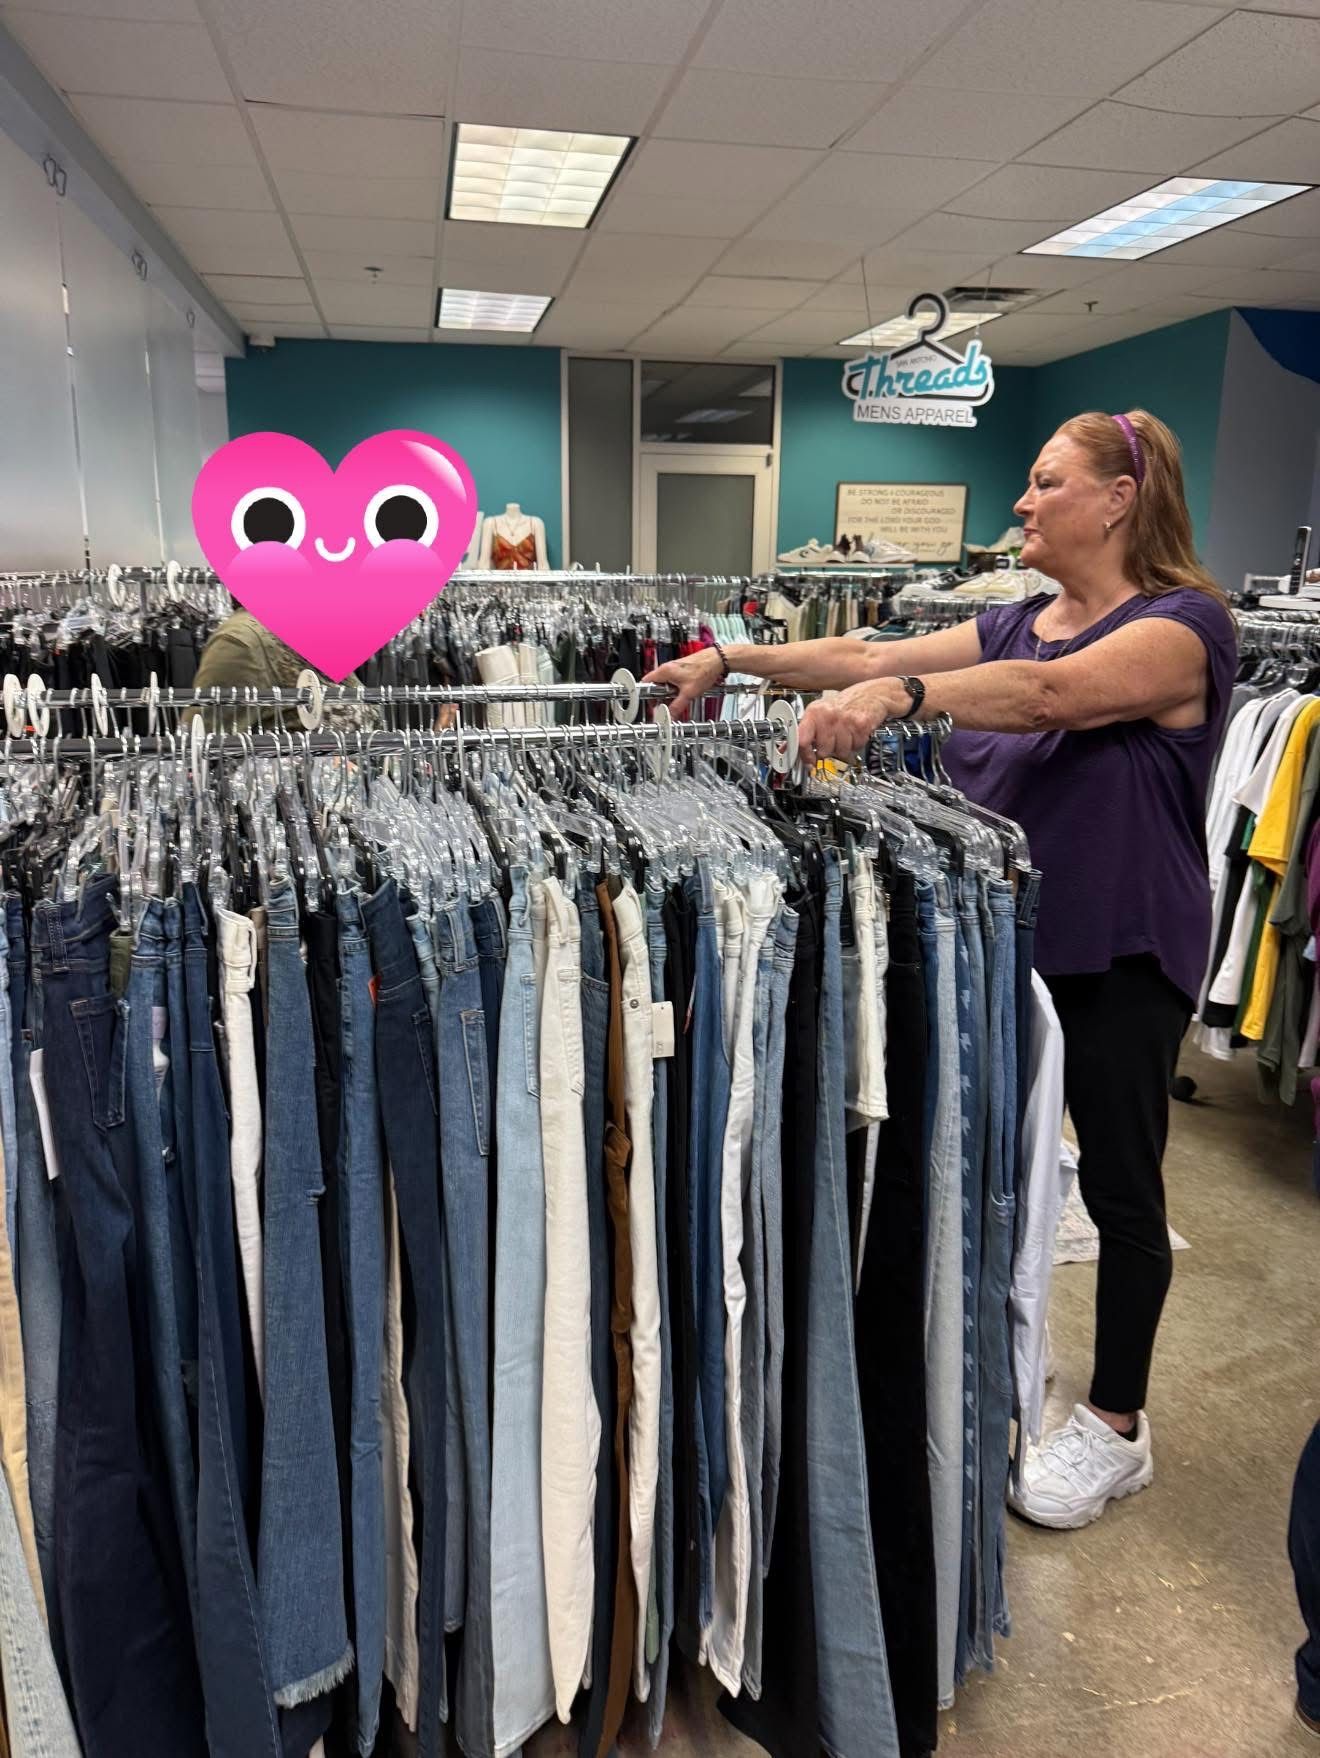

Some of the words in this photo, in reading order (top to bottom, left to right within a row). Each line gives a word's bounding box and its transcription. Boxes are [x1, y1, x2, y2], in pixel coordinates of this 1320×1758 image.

[848, 345, 988, 400] Threads
[857, 404, 901, 420] MENS
[904, 407, 973, 424] APPAREL
[858, 489, 889, 497] STRONG
[895, 489, 945, 498] COURAGEOUS
[904, 507, 956, 515] DISCOURAGED
[848, 516, 863, 524] FOR
[880, 516, 901, 524] LORD
